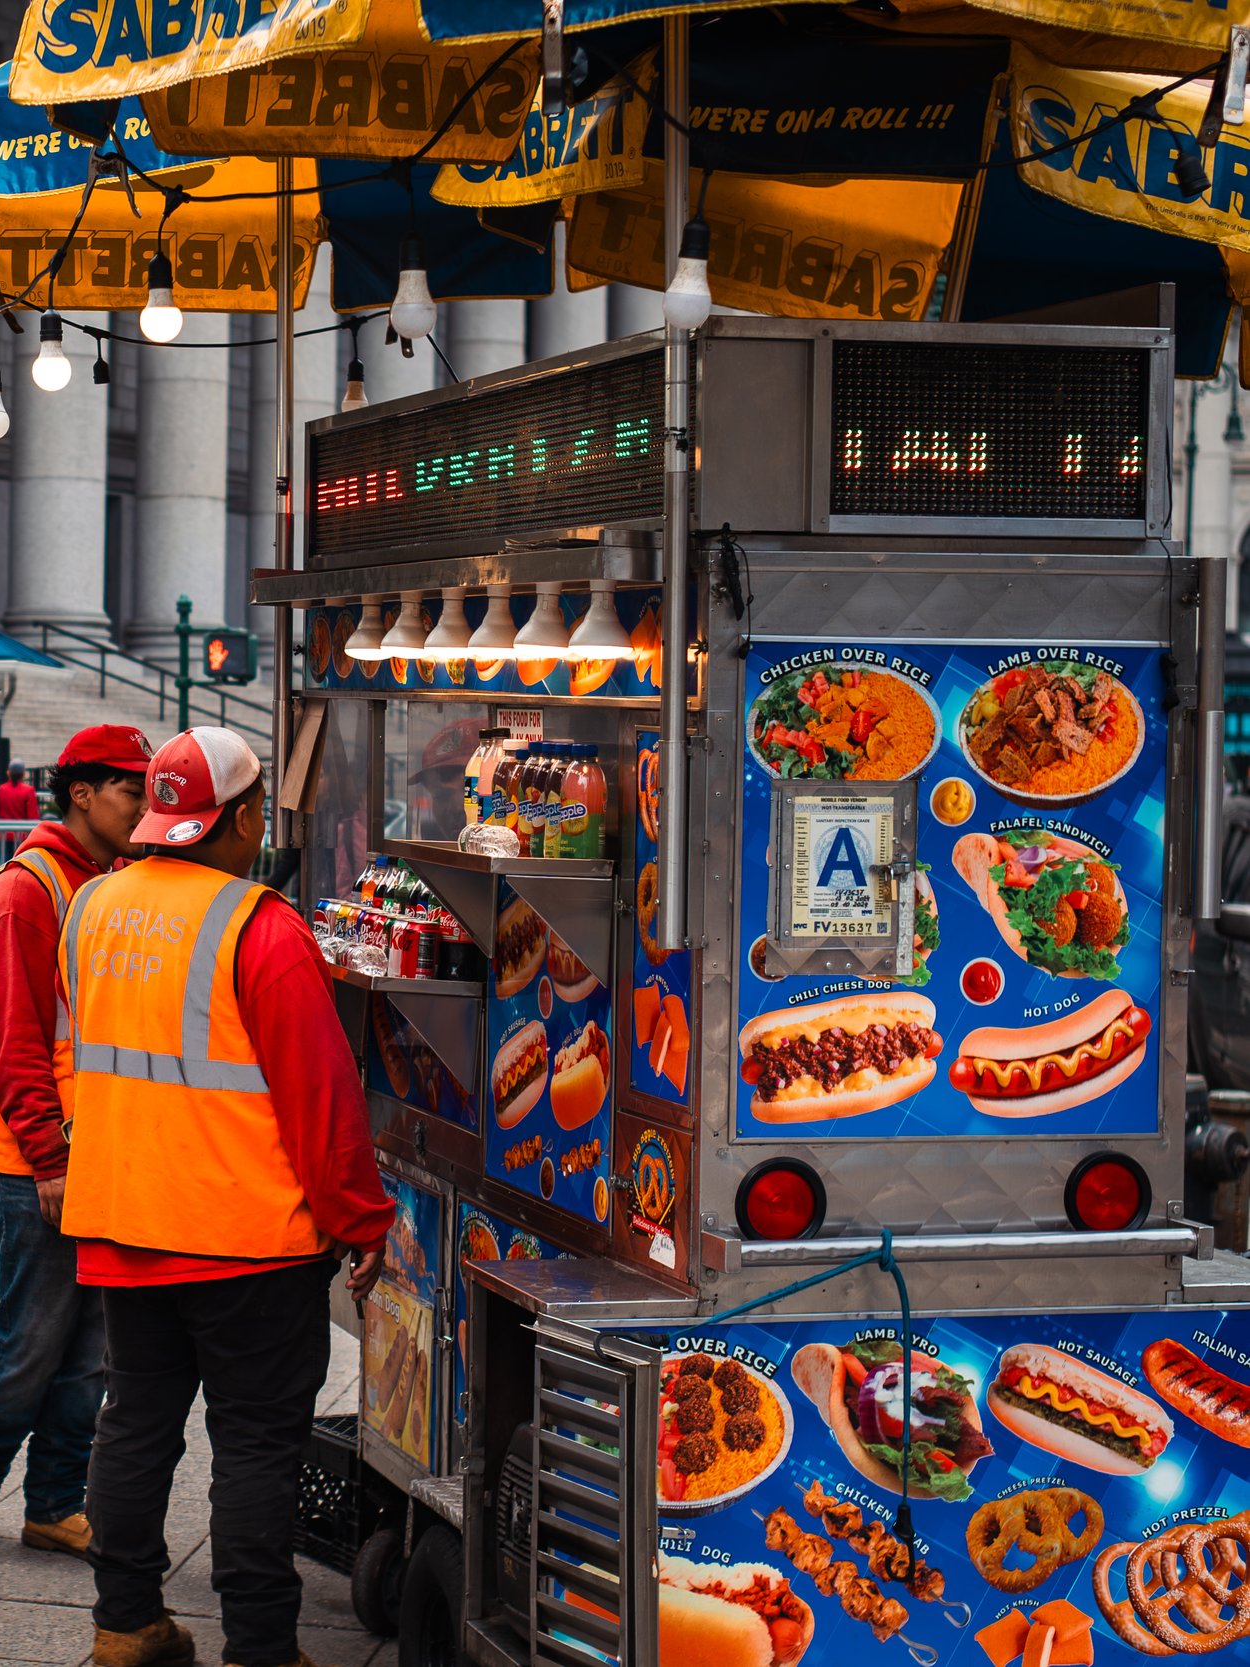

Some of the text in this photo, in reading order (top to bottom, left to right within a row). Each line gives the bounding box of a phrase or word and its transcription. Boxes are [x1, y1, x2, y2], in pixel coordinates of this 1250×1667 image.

[295, 16, 326, 40] 2019
[687, 105, 769, 135] WE'RE
[840, 106, 909, 131] ROLL
[605, 162, 625, 179] 2019
[1145, 203, 1158, 213] This
[1160, 205, 1186, 220] Umbrella
[760, 648, 931, 685] CHICKEN OVER RICE
[987, 647, 1124, 676] LAMB OVER RICE
[499, 711, 541, 727] THIS FOOD FOR
[990, 818, 1111, 857] FALAFEL SANDWICH
[816, 828, 867, 887] A
[105, 907, 187, 944] ARIAS
[788, 980, 891, 1004] CHILI CHEESE DOG
[1023, 993, 1080, 1018] HOT DOG
[385, 1292, 400, 1324] Dog
[855, 1328, 938, 1355] LAMB YRO
[1192, 1330, 1237, 1359] ITALIAN
[676, 1337, 777, 1377] OVER RICE
[1057, 1339, 1138, 1387] HOT SAUSAGE
[835, 1482, 892, 1521] CHICKEN
[997, 1477, 1066, 1499] CHEESE PRETZEL
[1142, 1507, 1228, 1539] HOT PRETZEL
[659, 1538, 731, 1563] HILI DOG
[995, 1599, 1040, 1620] HOT KNISH
